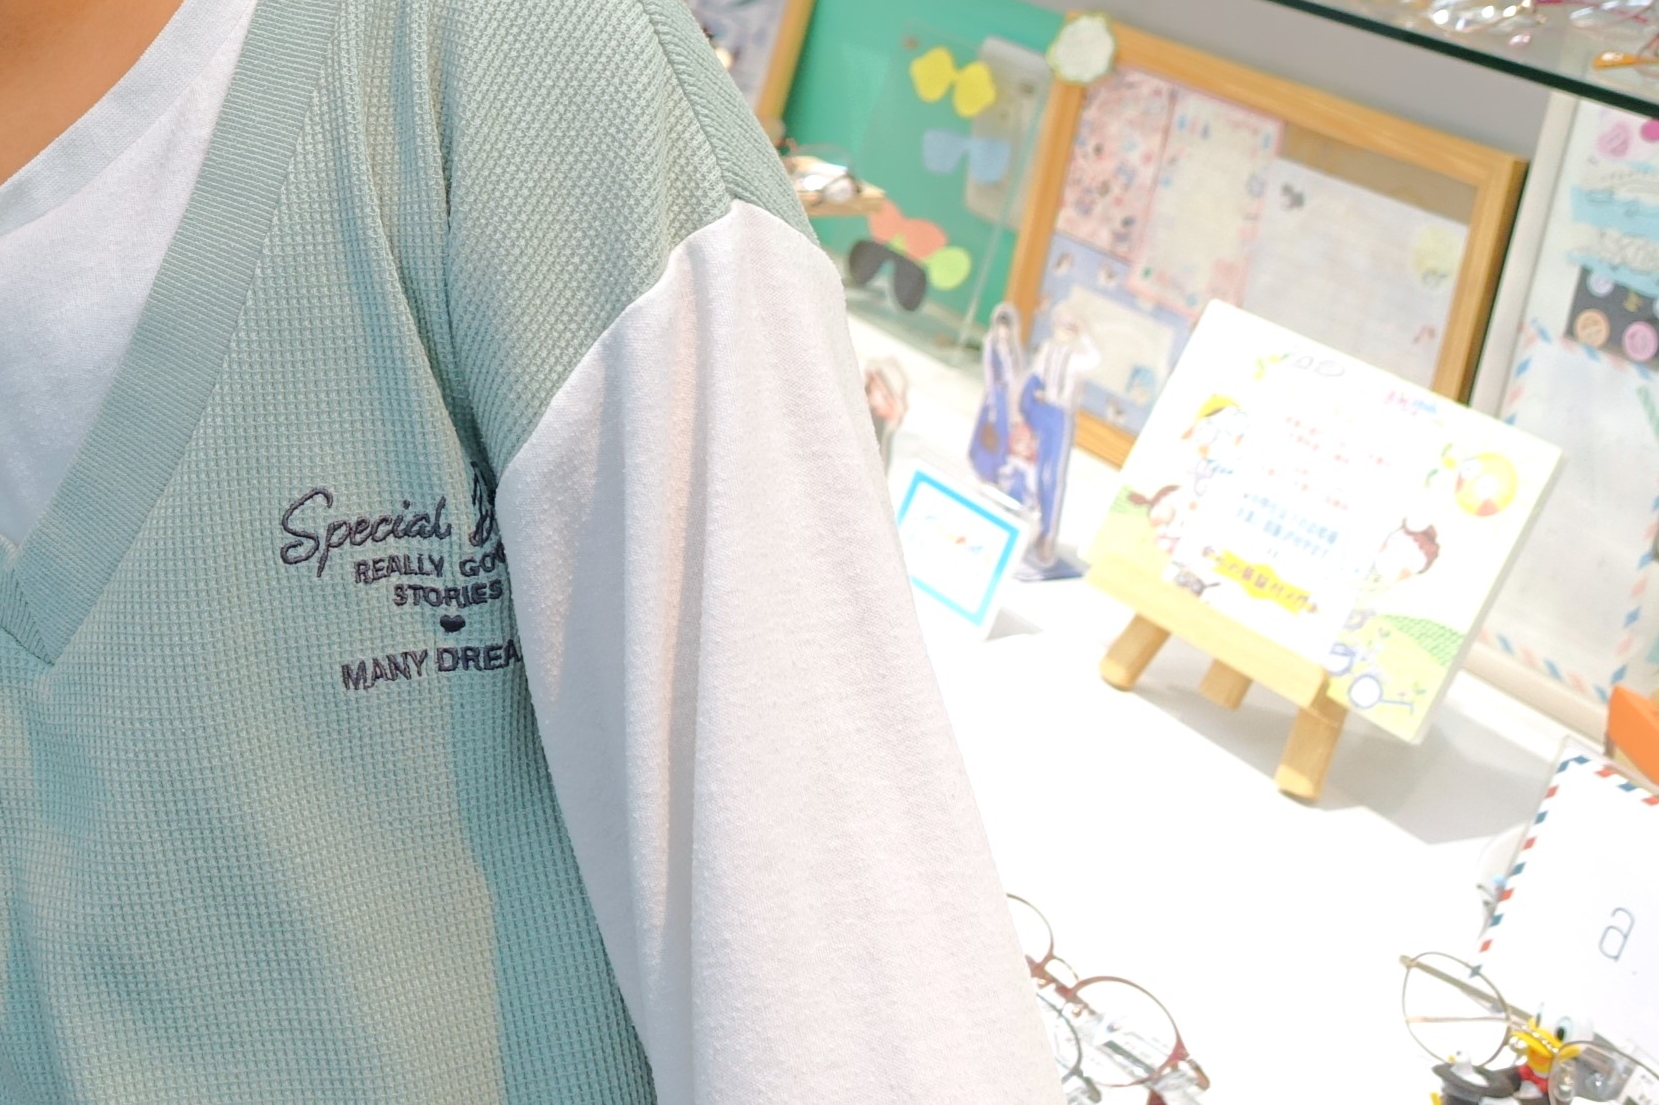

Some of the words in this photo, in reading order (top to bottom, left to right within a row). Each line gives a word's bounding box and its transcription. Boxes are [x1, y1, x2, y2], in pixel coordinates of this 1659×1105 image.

[279, 487, 452, 578] Special
[354, 553, 445, 584] REALLY
[391, 579, 503, 610] STORIES
[341, 648, 429, 691] MANY
[436, 638, 523, 673] DREA
